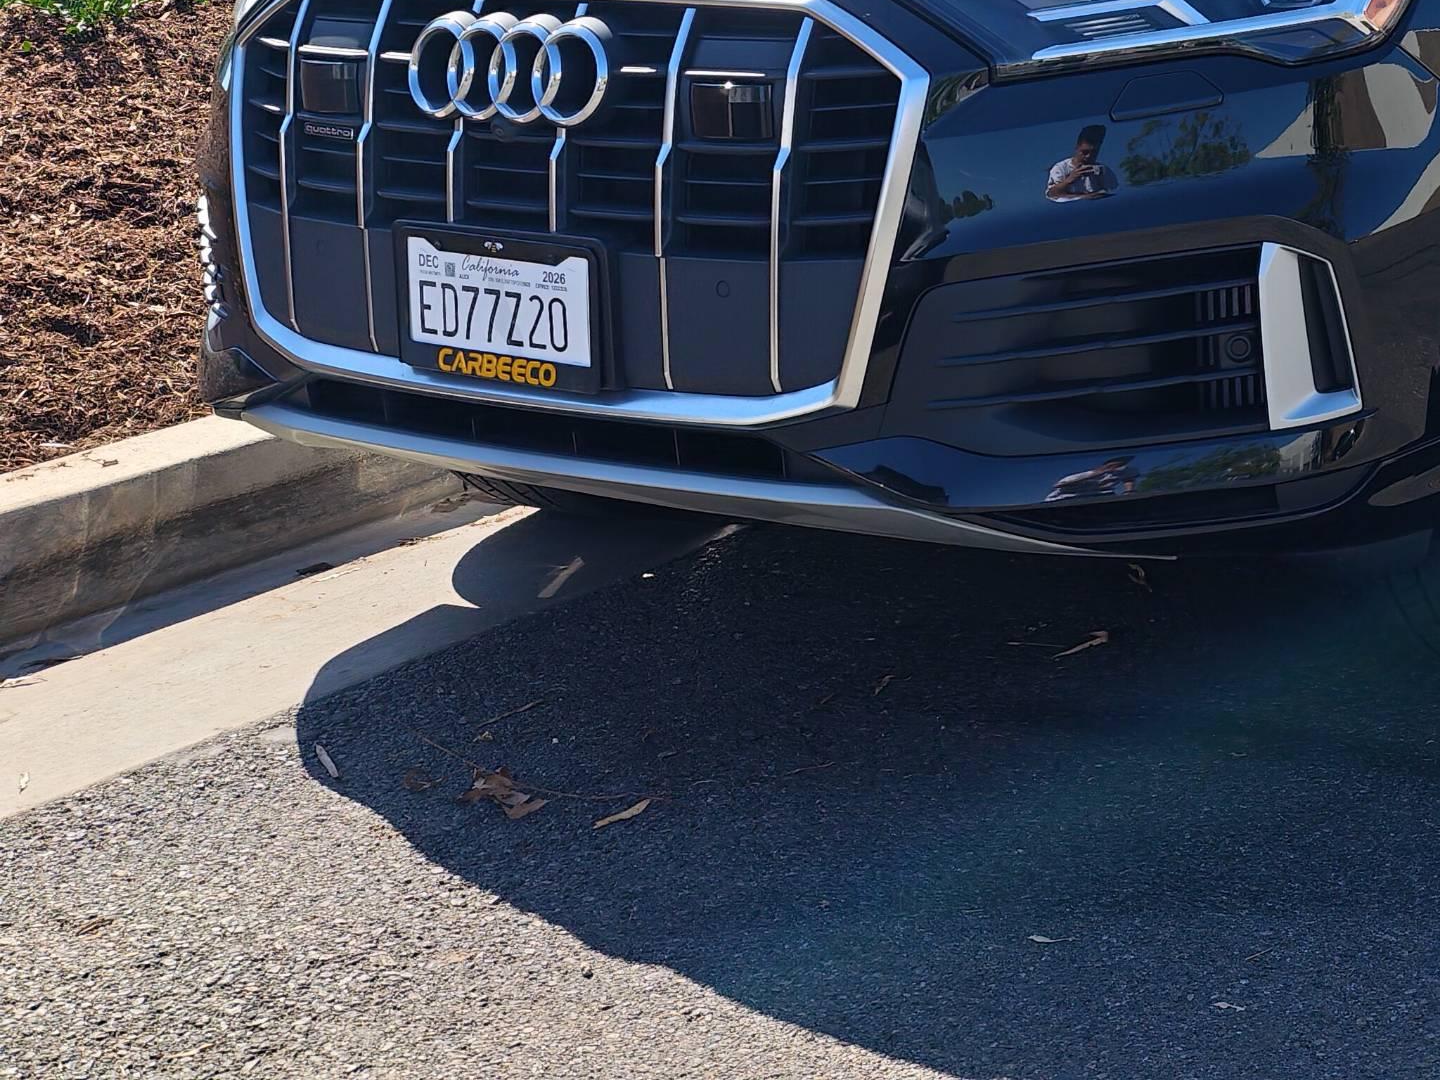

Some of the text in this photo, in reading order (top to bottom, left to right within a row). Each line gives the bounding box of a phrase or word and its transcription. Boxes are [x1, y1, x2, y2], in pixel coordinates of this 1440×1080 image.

[306, 125, 350, 137] quattro
[418, 253, 439, 269] DEC
[461, 254, 520, 282] California
[542, 271, 566, 285] 2026
[419, 279, 568, 353] ED77Z20
[437, 347, 558, 388] CARBEECO
